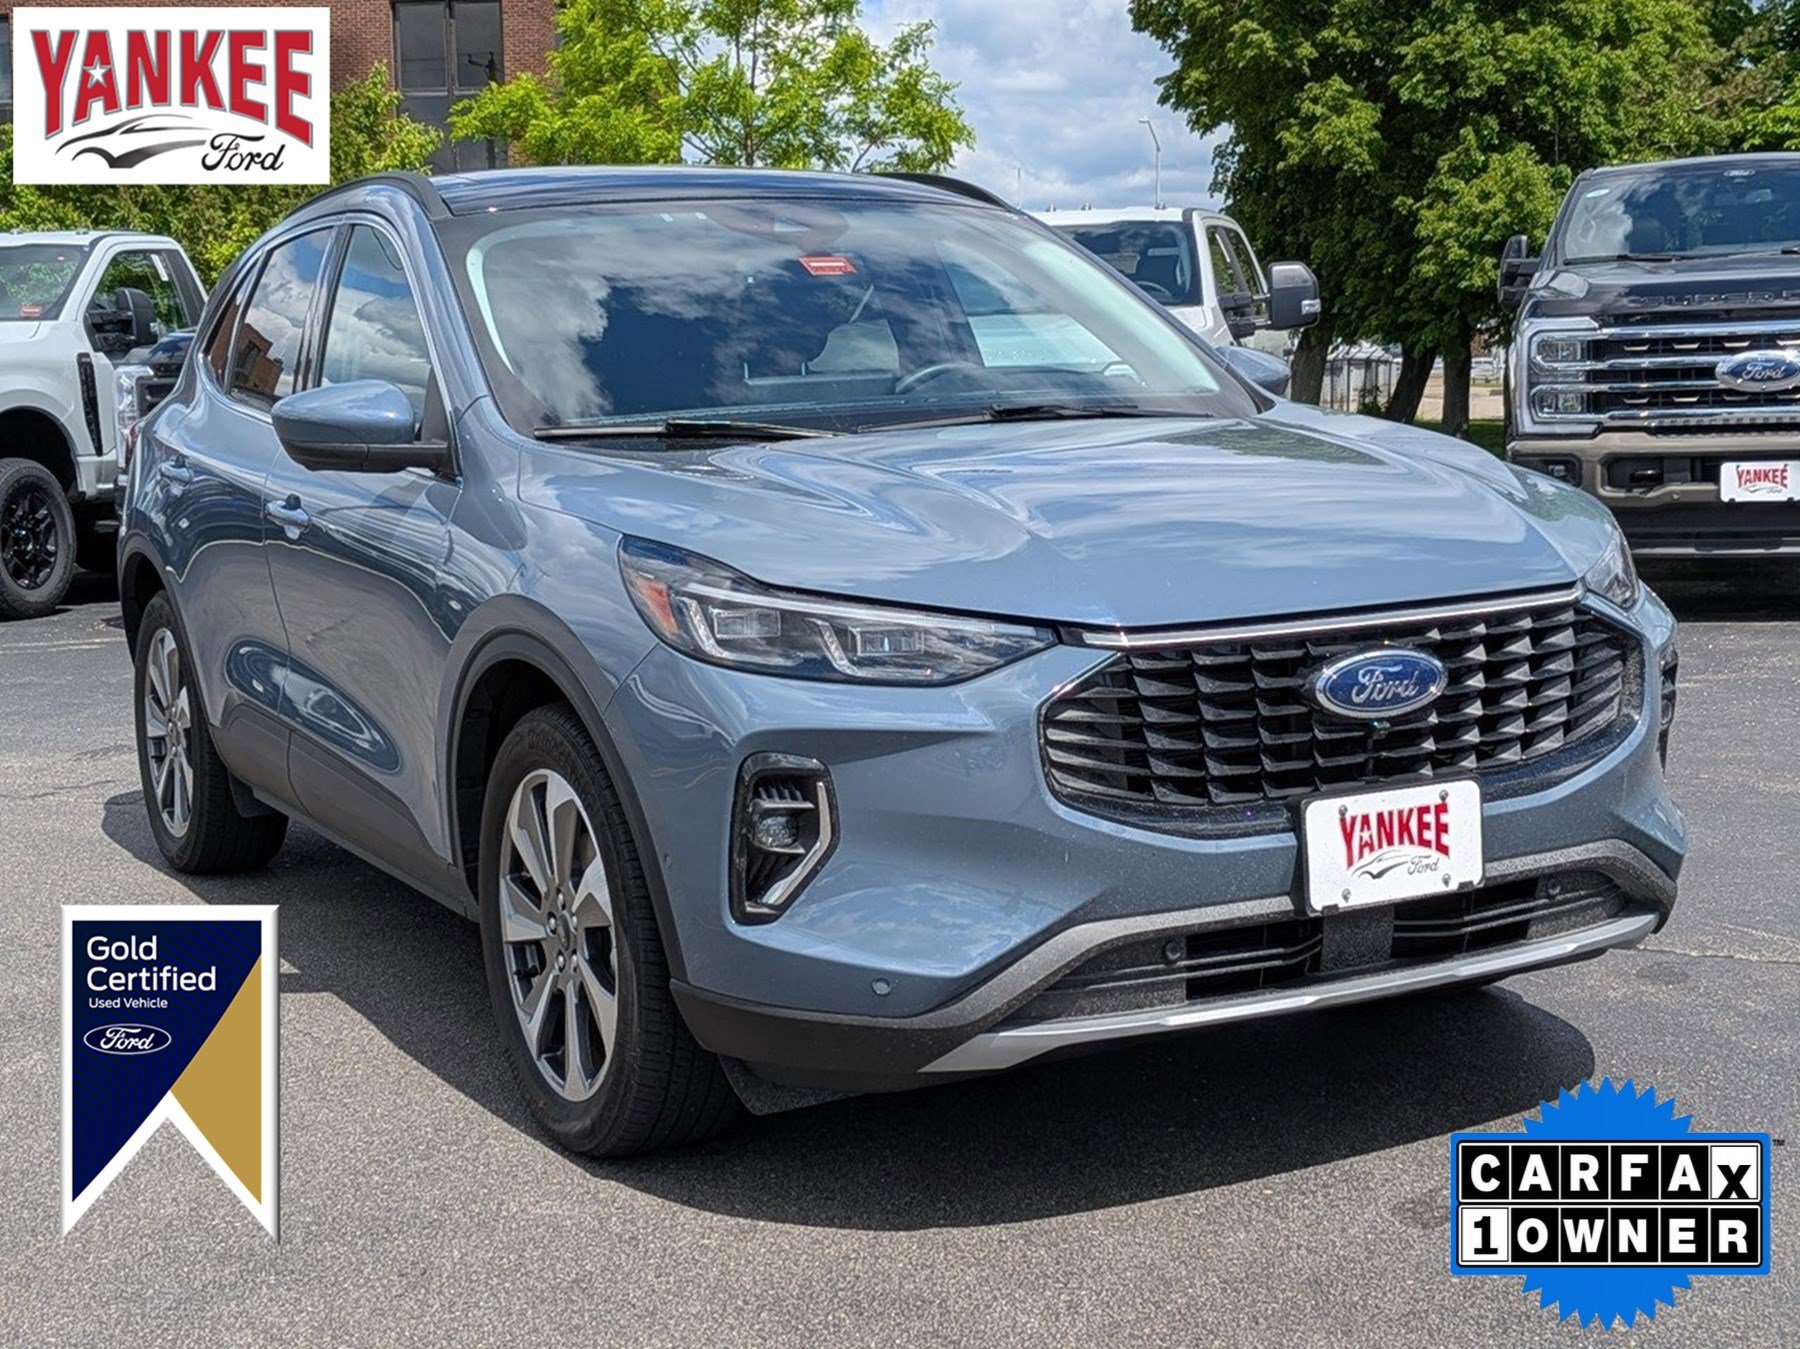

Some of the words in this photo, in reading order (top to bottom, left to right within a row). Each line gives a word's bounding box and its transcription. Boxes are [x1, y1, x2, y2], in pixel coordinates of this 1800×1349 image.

[1741, 361, 1787, 380] Ford
[1735, 467, 1788, 489] YANKEE
[1351, 664, 1420, 704] Ford
[1339, 803, 1449, 869] YANKEE
[1407, 855, 1440, 876] Ford
